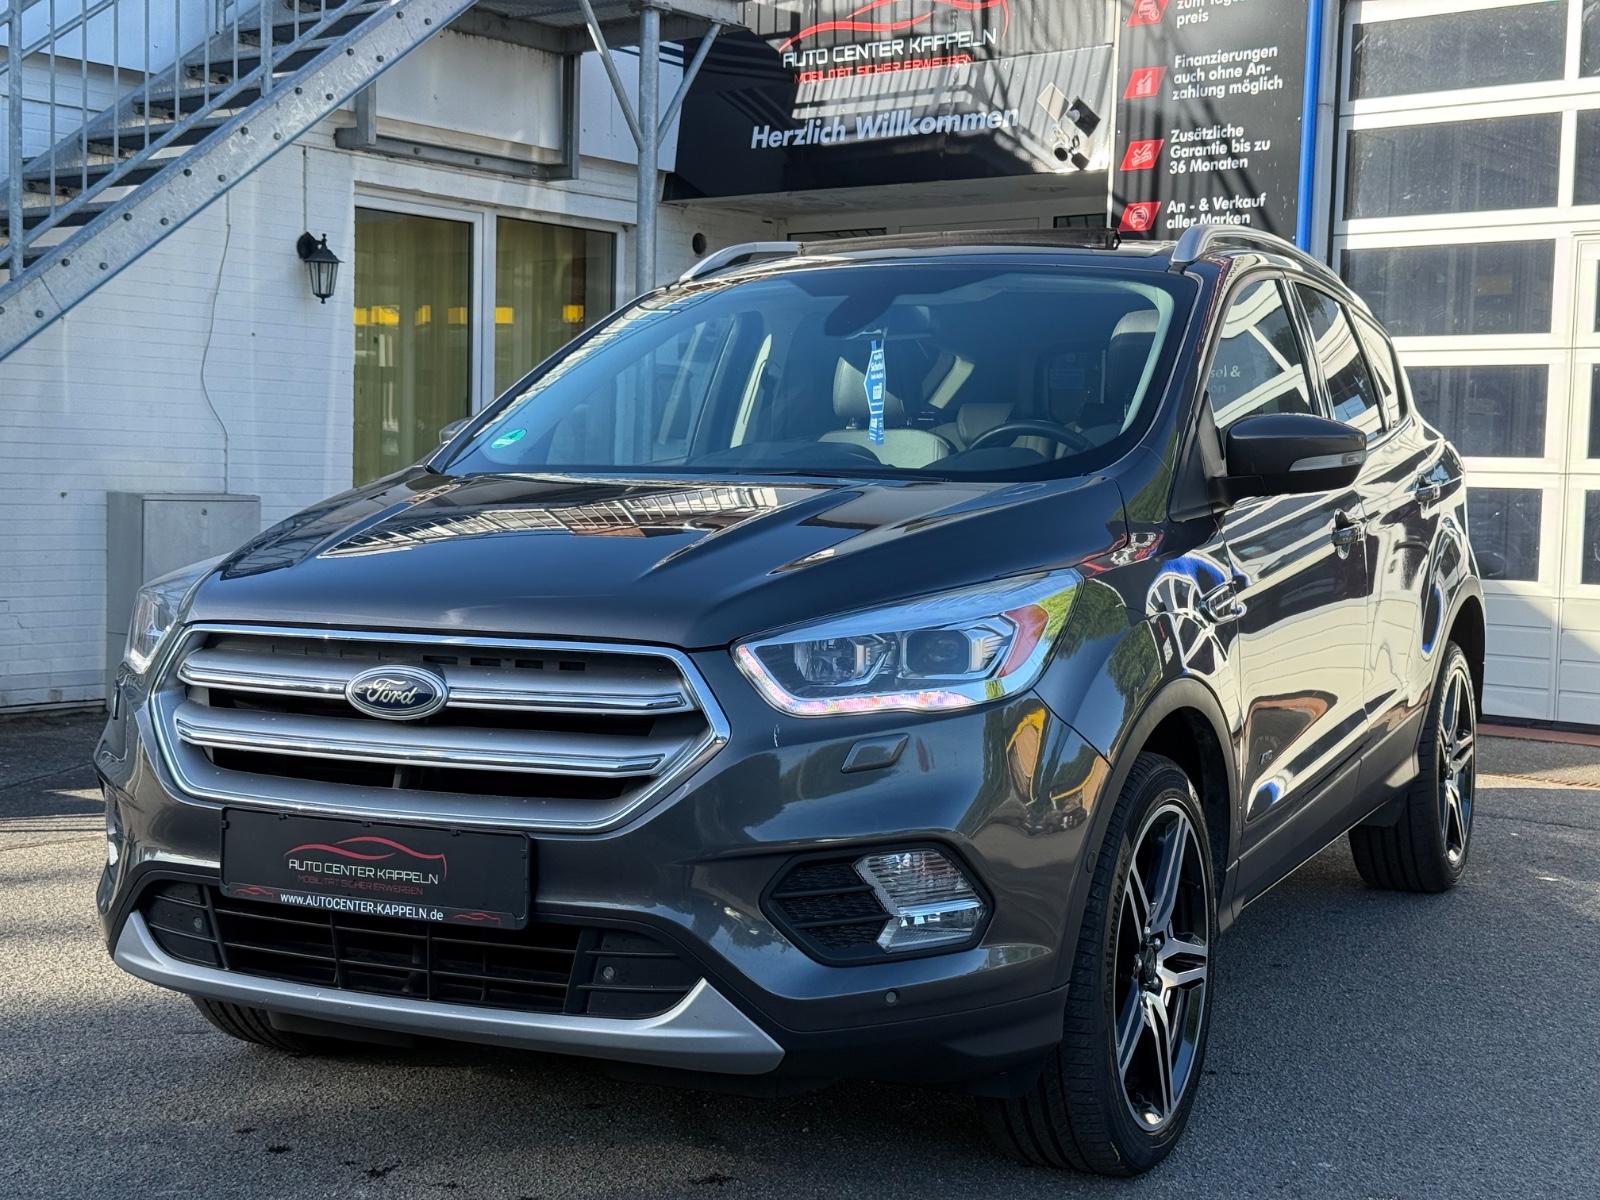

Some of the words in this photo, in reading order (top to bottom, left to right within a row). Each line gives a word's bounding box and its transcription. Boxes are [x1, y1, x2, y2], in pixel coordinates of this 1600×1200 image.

[1176, 8, 1209, 29] preis
[782, 49, 828, 68] AUTO
[833, 39, 904, 63] CENTER
[909, 28, 997, 53] KAPPELN
[1174, 46, 1278, 68] Finanzierungen
[857, 62, 901, 77] SICHER
[1174, 69, 1205, 84] auch
[1209, 66, 1242, 80] ohne
[1245, 63, 1271, 76] An-
[1172, 81, 1226, 101] zahlung
[1229, 75, 1283, 95] möglich
[750, 117, 846, 149] Herzlich
[855, 108, 1019, 140] Willkommen
[1170, 123, 1244, 143] Zusätzliche
[1170, 143, 1228, 159] Garantie
[1231, 138, 1251, 153] bis
[1253, 139, 1271, 151] zu
[1169, 161, 1186, 175] 36
[1189, 157, 1248, 172] Monaten
[1166, 200, 1186, 214] An
[1199, 197, 1210, 212] &
[1213, 192, 1267, 211] Verkauf
[1166, 213, 1197, 229] aller
[1200, 210, 1251, 225] Marken
[367, 678, 417, 704] Ford
[288, 858, 322, 873] AUTO
[324, 862, 375, 878] CENTER
[377, 868, 439, 885] KAPPELN
[280, 893, 444, 921] www.AUTOCENTER-KAPPELN.de
